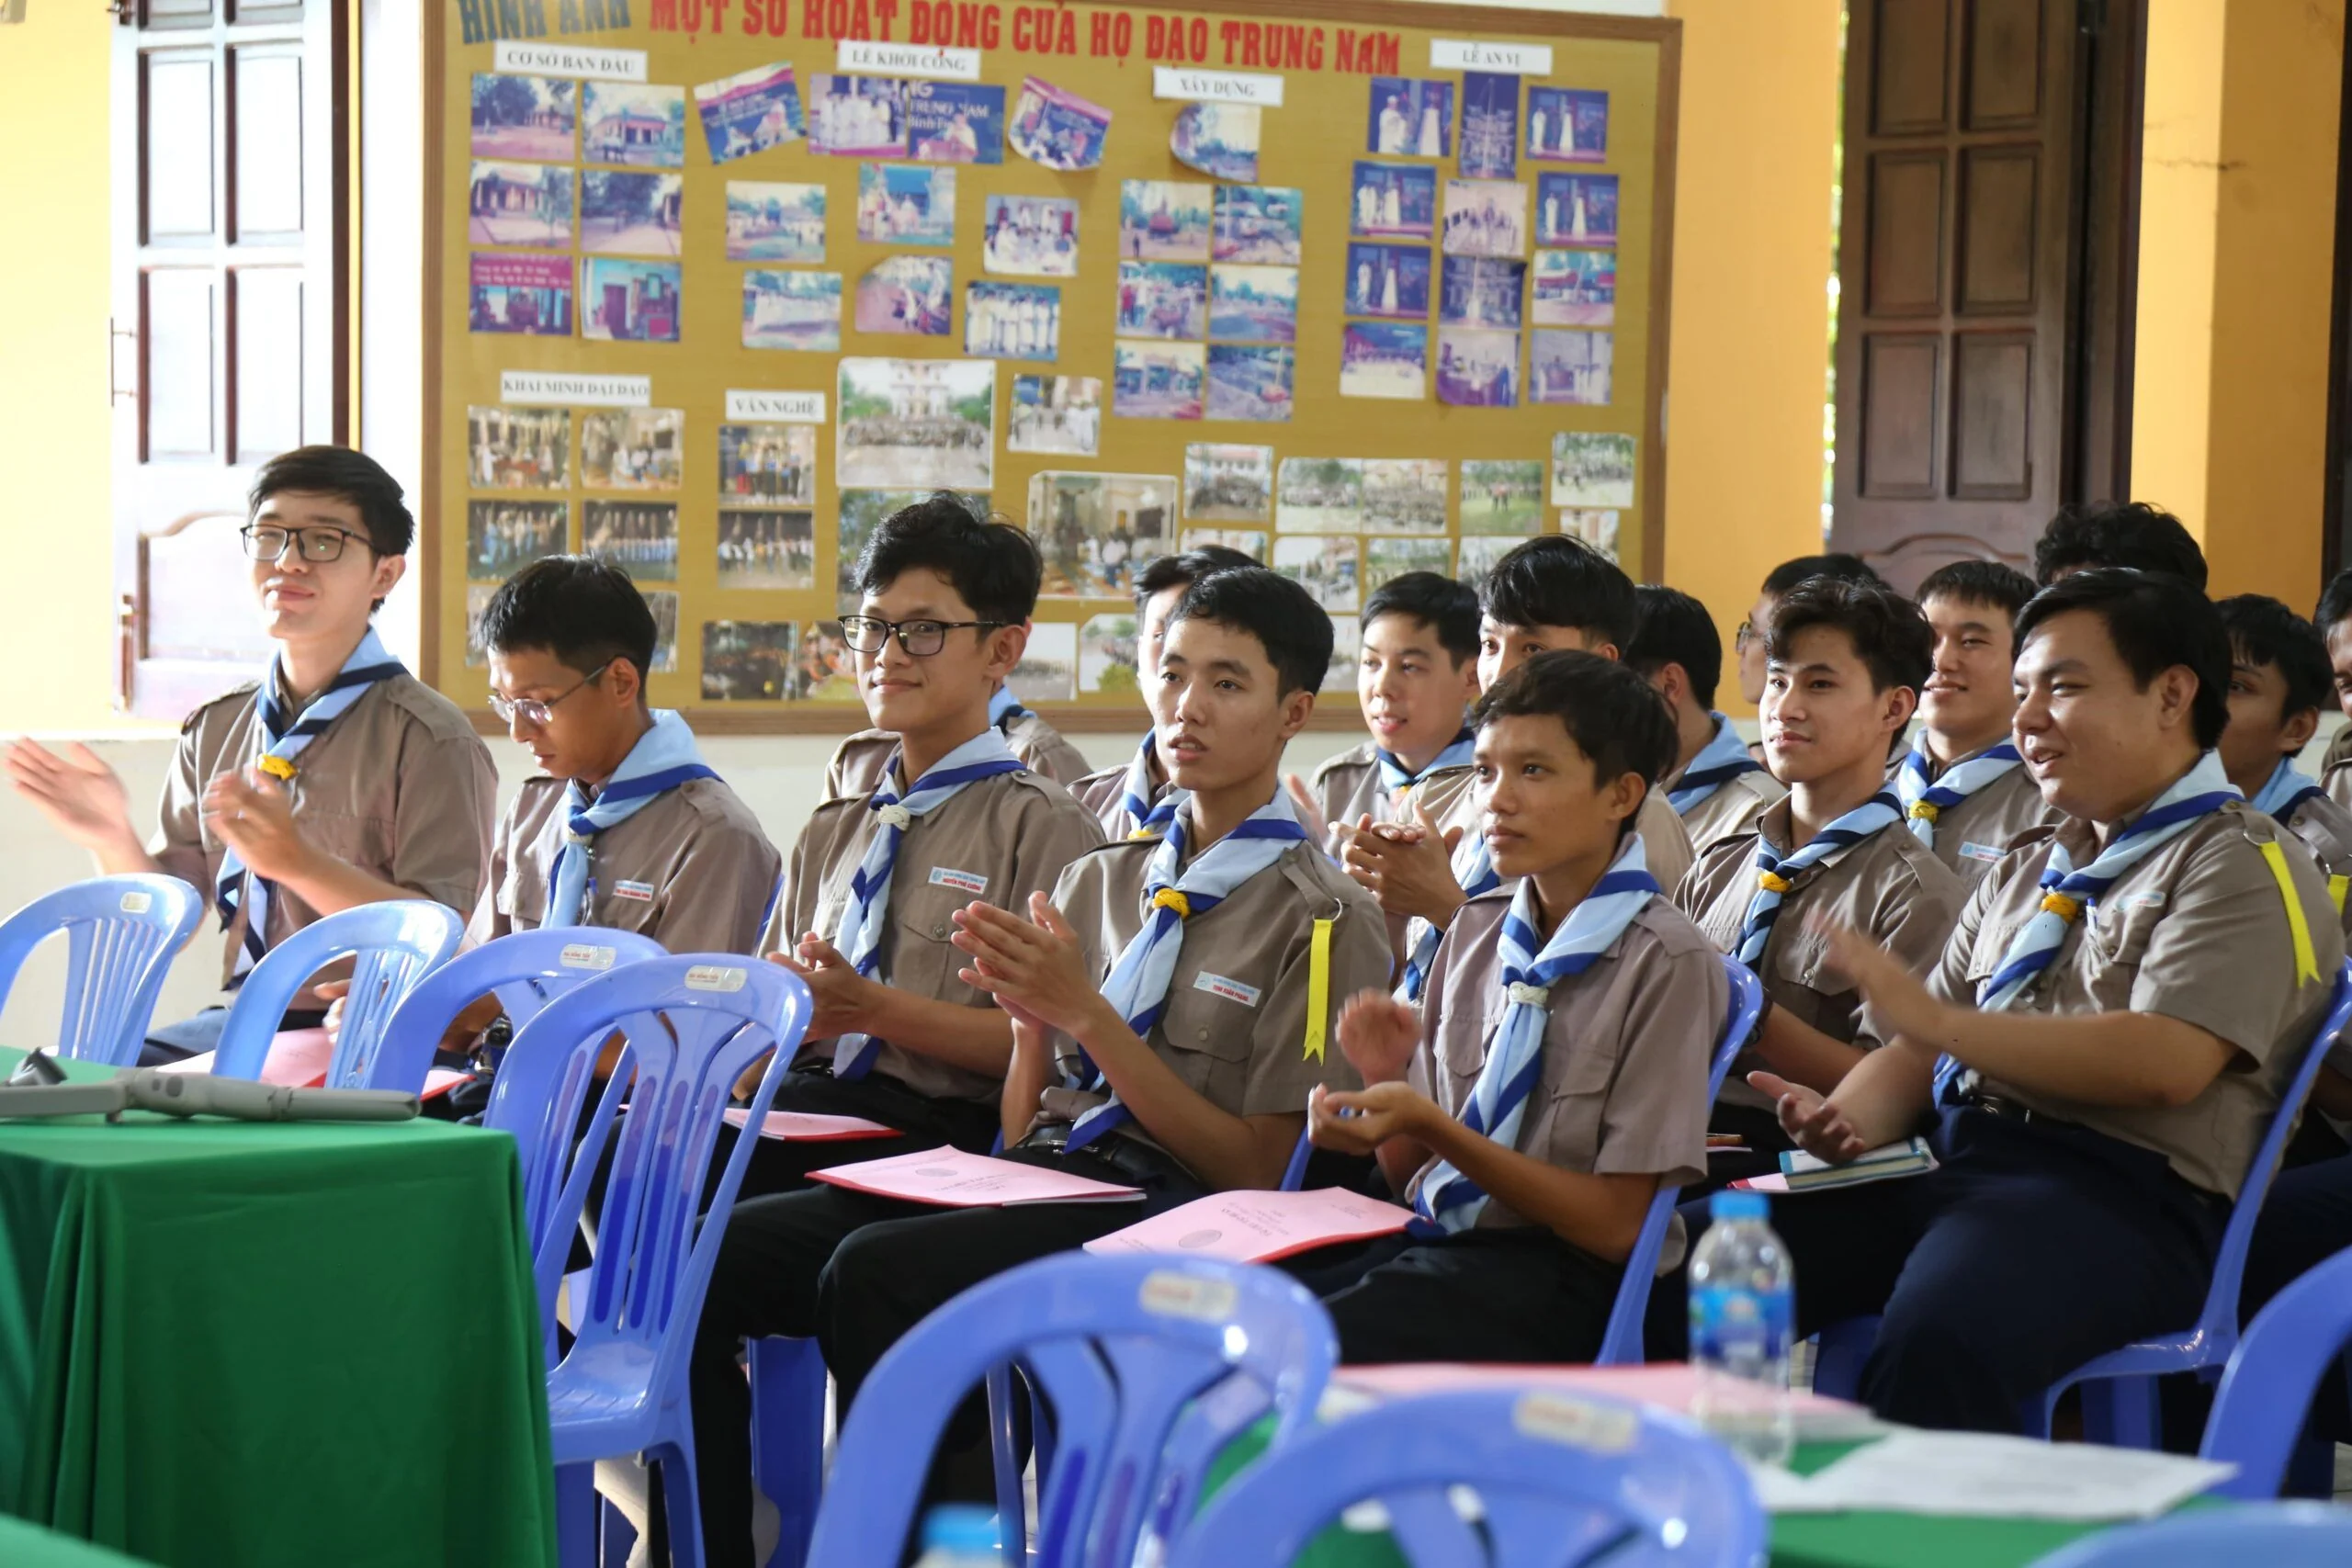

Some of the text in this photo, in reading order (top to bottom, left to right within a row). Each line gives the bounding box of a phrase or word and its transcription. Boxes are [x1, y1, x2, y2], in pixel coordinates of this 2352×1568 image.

[562, 54, 595, 70] BAN
[1090, 11, 1132, 68] HỌ
[1220, 20, 1325, 69] TRUNG
[1335, 28, 1400, 75] NAM
